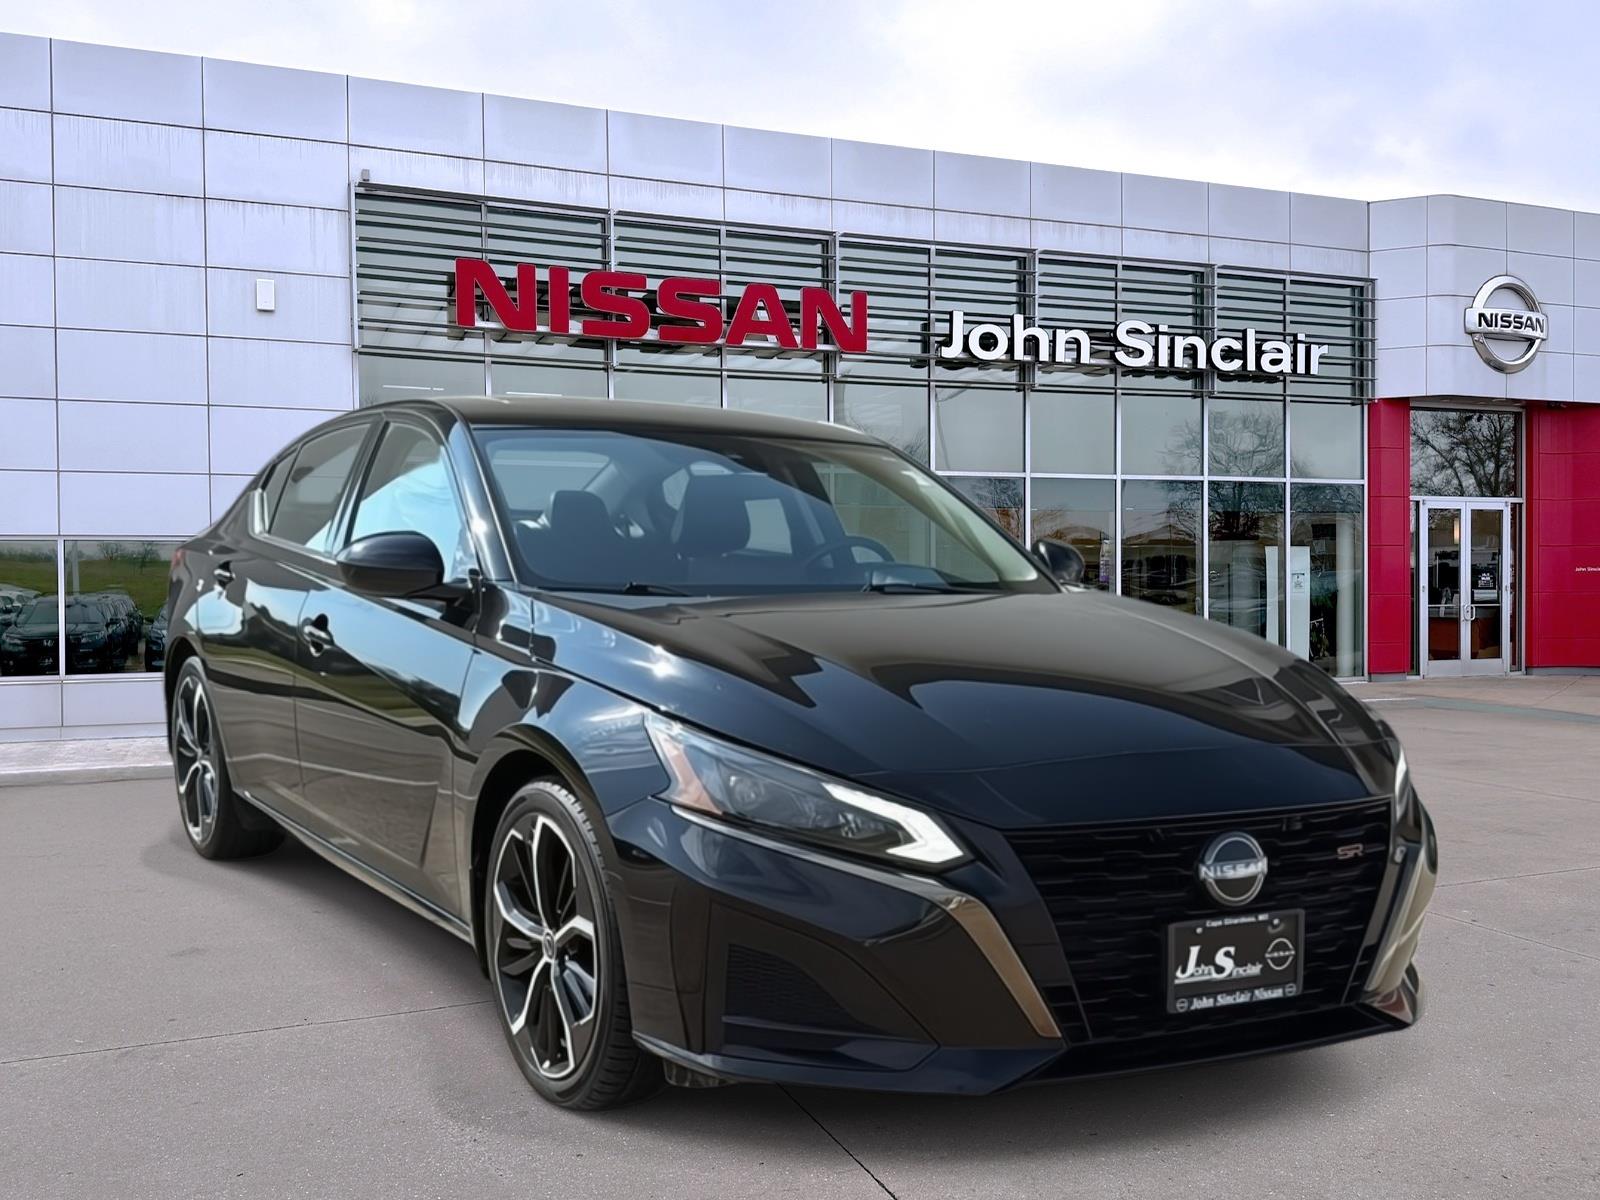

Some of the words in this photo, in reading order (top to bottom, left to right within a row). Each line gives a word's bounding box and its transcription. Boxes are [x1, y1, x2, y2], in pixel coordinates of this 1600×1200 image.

[454, 257, 868, 353] NISSAN
[1477, 312, 1545, 333] NISSAN
[939, 310, 1091, 364] John
[1114, 319, 1329, 375] Sinclair
[1337, 843, 1363, 860] SR
[1200, 858, 1266, 880] NISSAN
[1190, 996, 1214, 1011] John
[1215, 991, 1252, 1006] Sinclair
[1252, 987, 1283, 1002] Nissan
